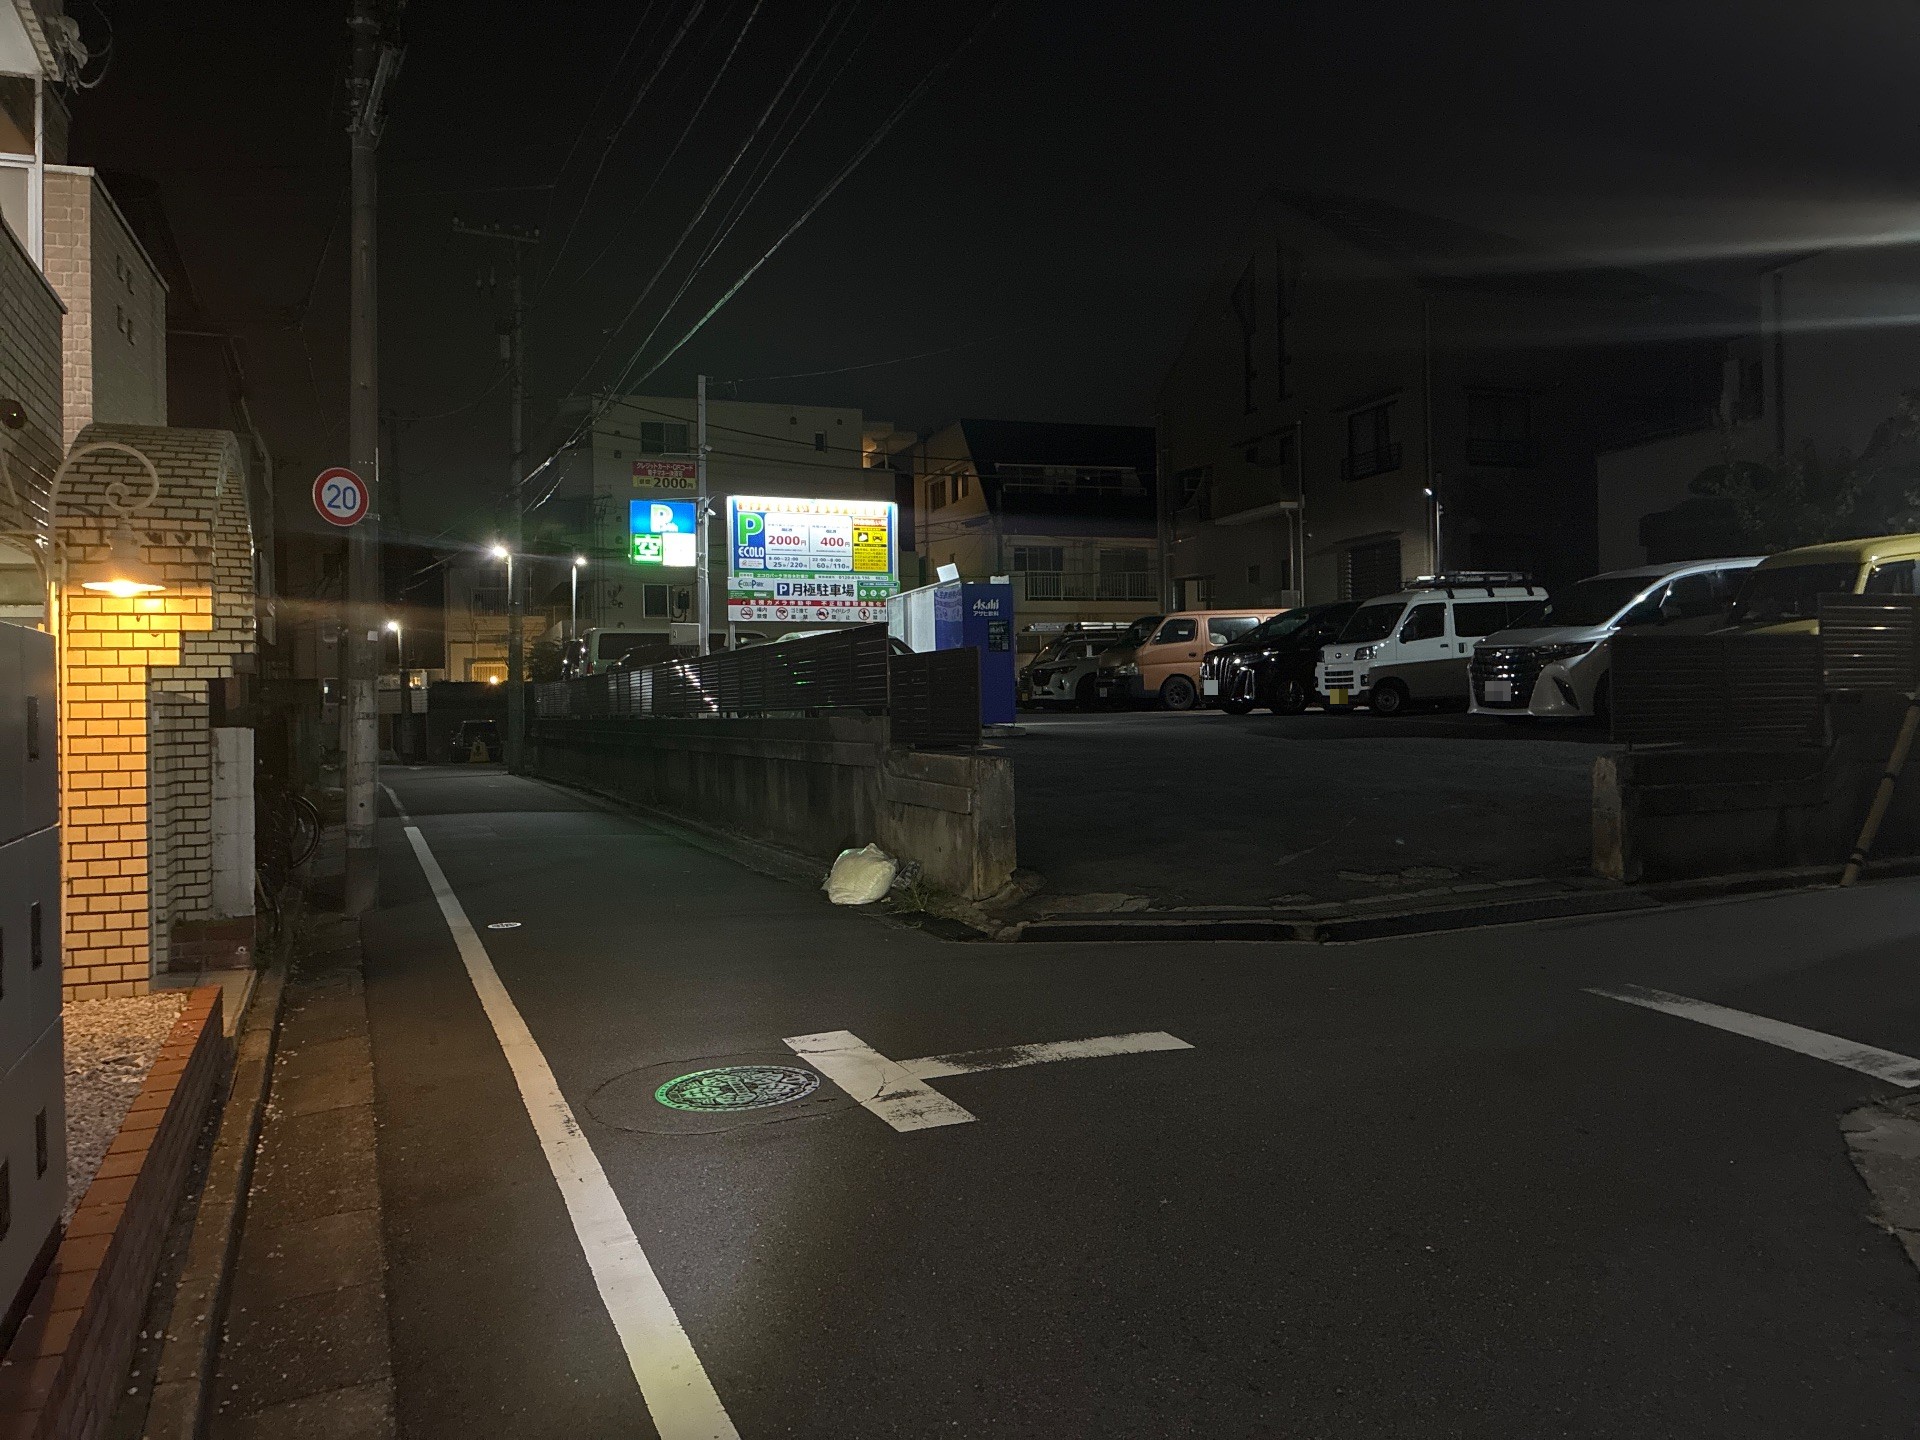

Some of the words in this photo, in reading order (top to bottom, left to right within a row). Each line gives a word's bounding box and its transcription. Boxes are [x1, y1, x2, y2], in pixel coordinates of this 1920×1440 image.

[653, 477, 693, 489] 2000円
[327, 484, 357, 510] 20
[738, 512, 764, 546] P
[768, 535, 807, 547] 2000円
[820, 537, 850, 548] 400円
[634, 533, 662, 562] 空
[738, 546, 765, 558] ECOLO
[792, 583, 854, 597] 月極駐車場
[973, 599, 999, 610] Asahi
